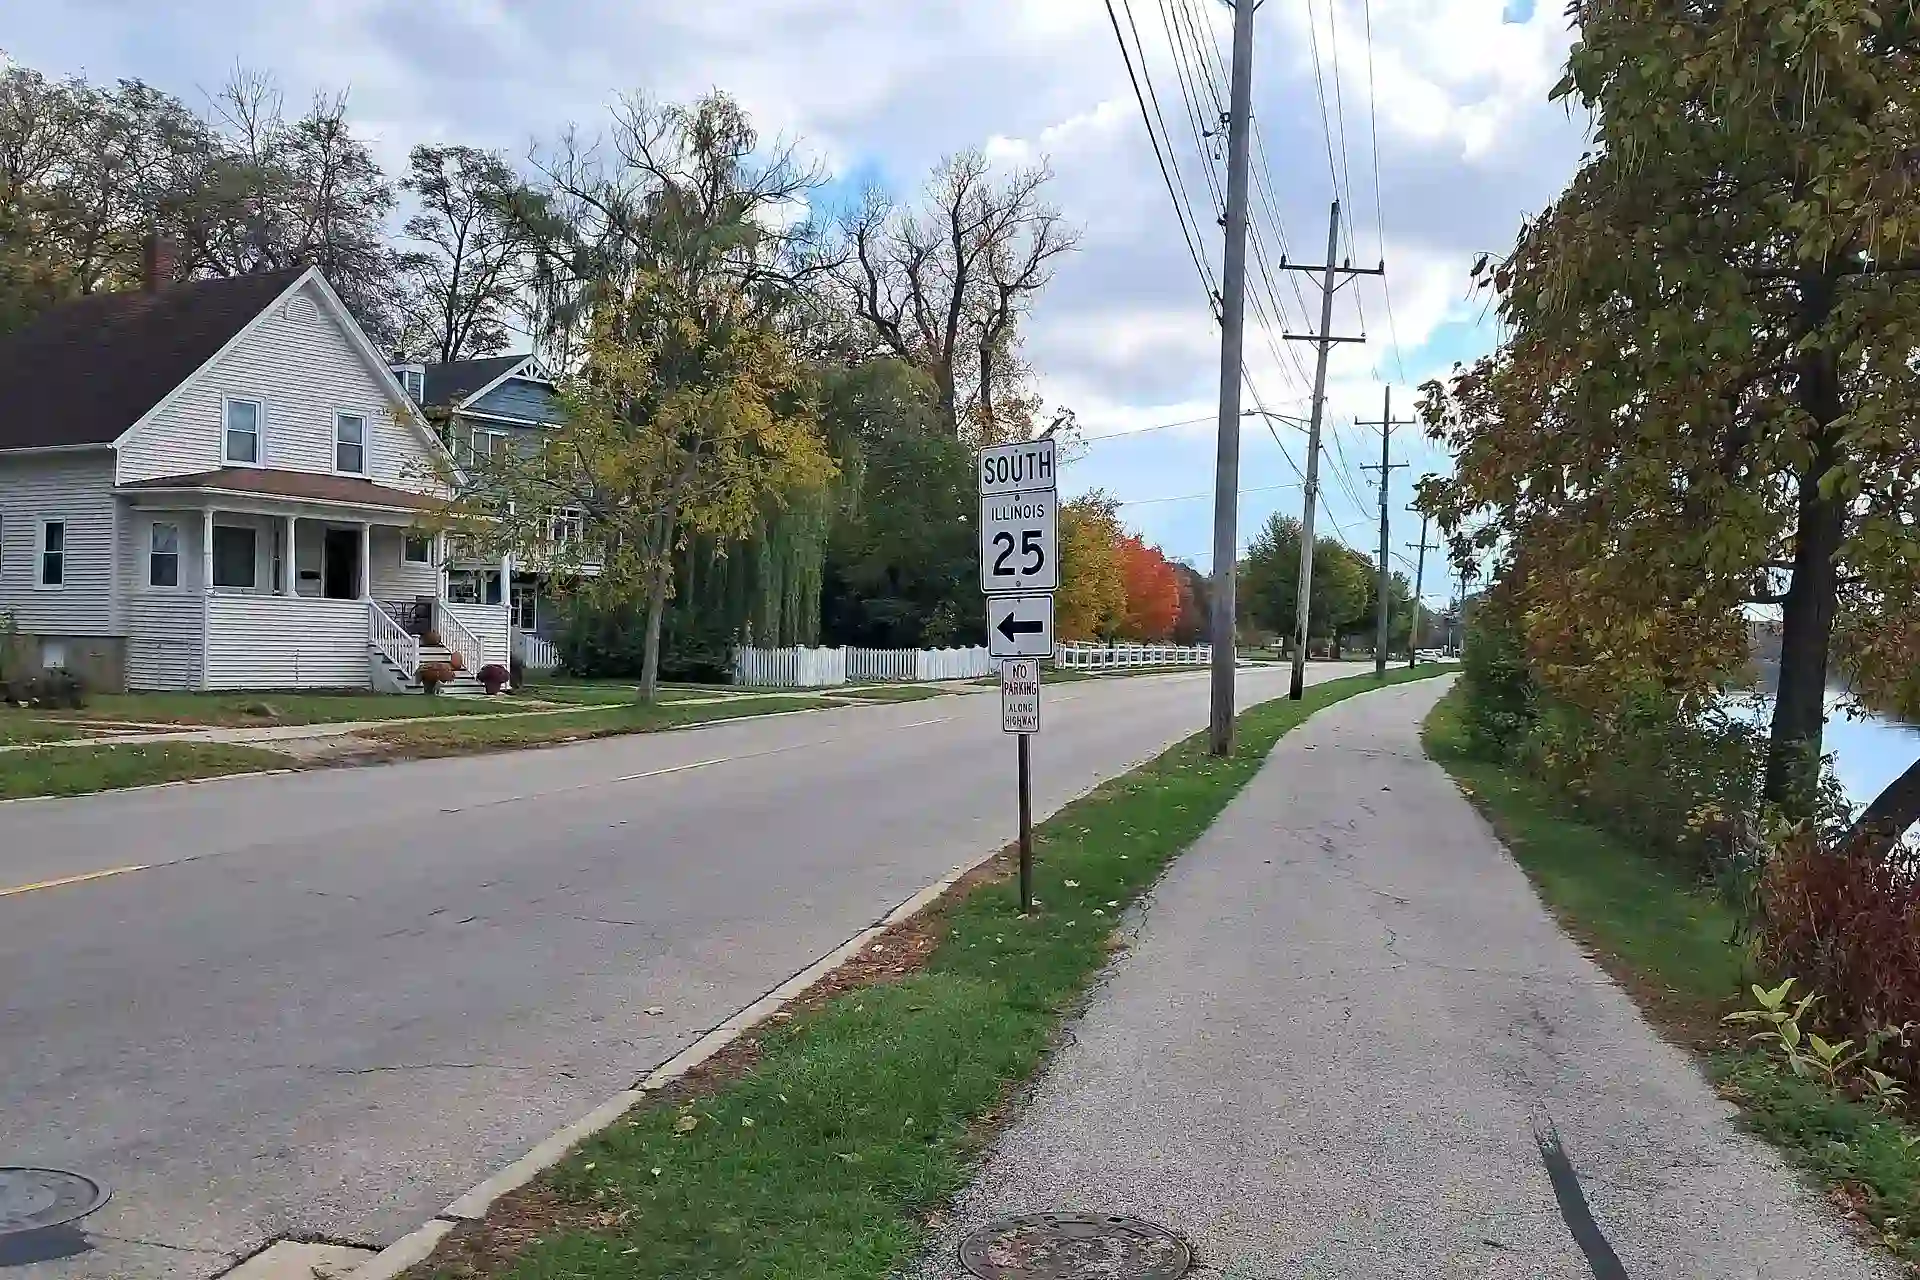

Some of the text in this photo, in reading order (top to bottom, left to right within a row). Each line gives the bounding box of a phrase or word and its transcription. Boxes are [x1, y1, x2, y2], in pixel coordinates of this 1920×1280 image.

[984, 450, 1051, 485] SOUTH
[991, 504, 1045, 521] ILLINOIS
[992, 530, 1045, 576] 25
[1012, 664, 1028, 679] NO
[1004, 682, 1037, 696] PARKING
[1008, 703, 1033, 713] ALONG
[1005, 715, 1037, 727] HIGHWAY
